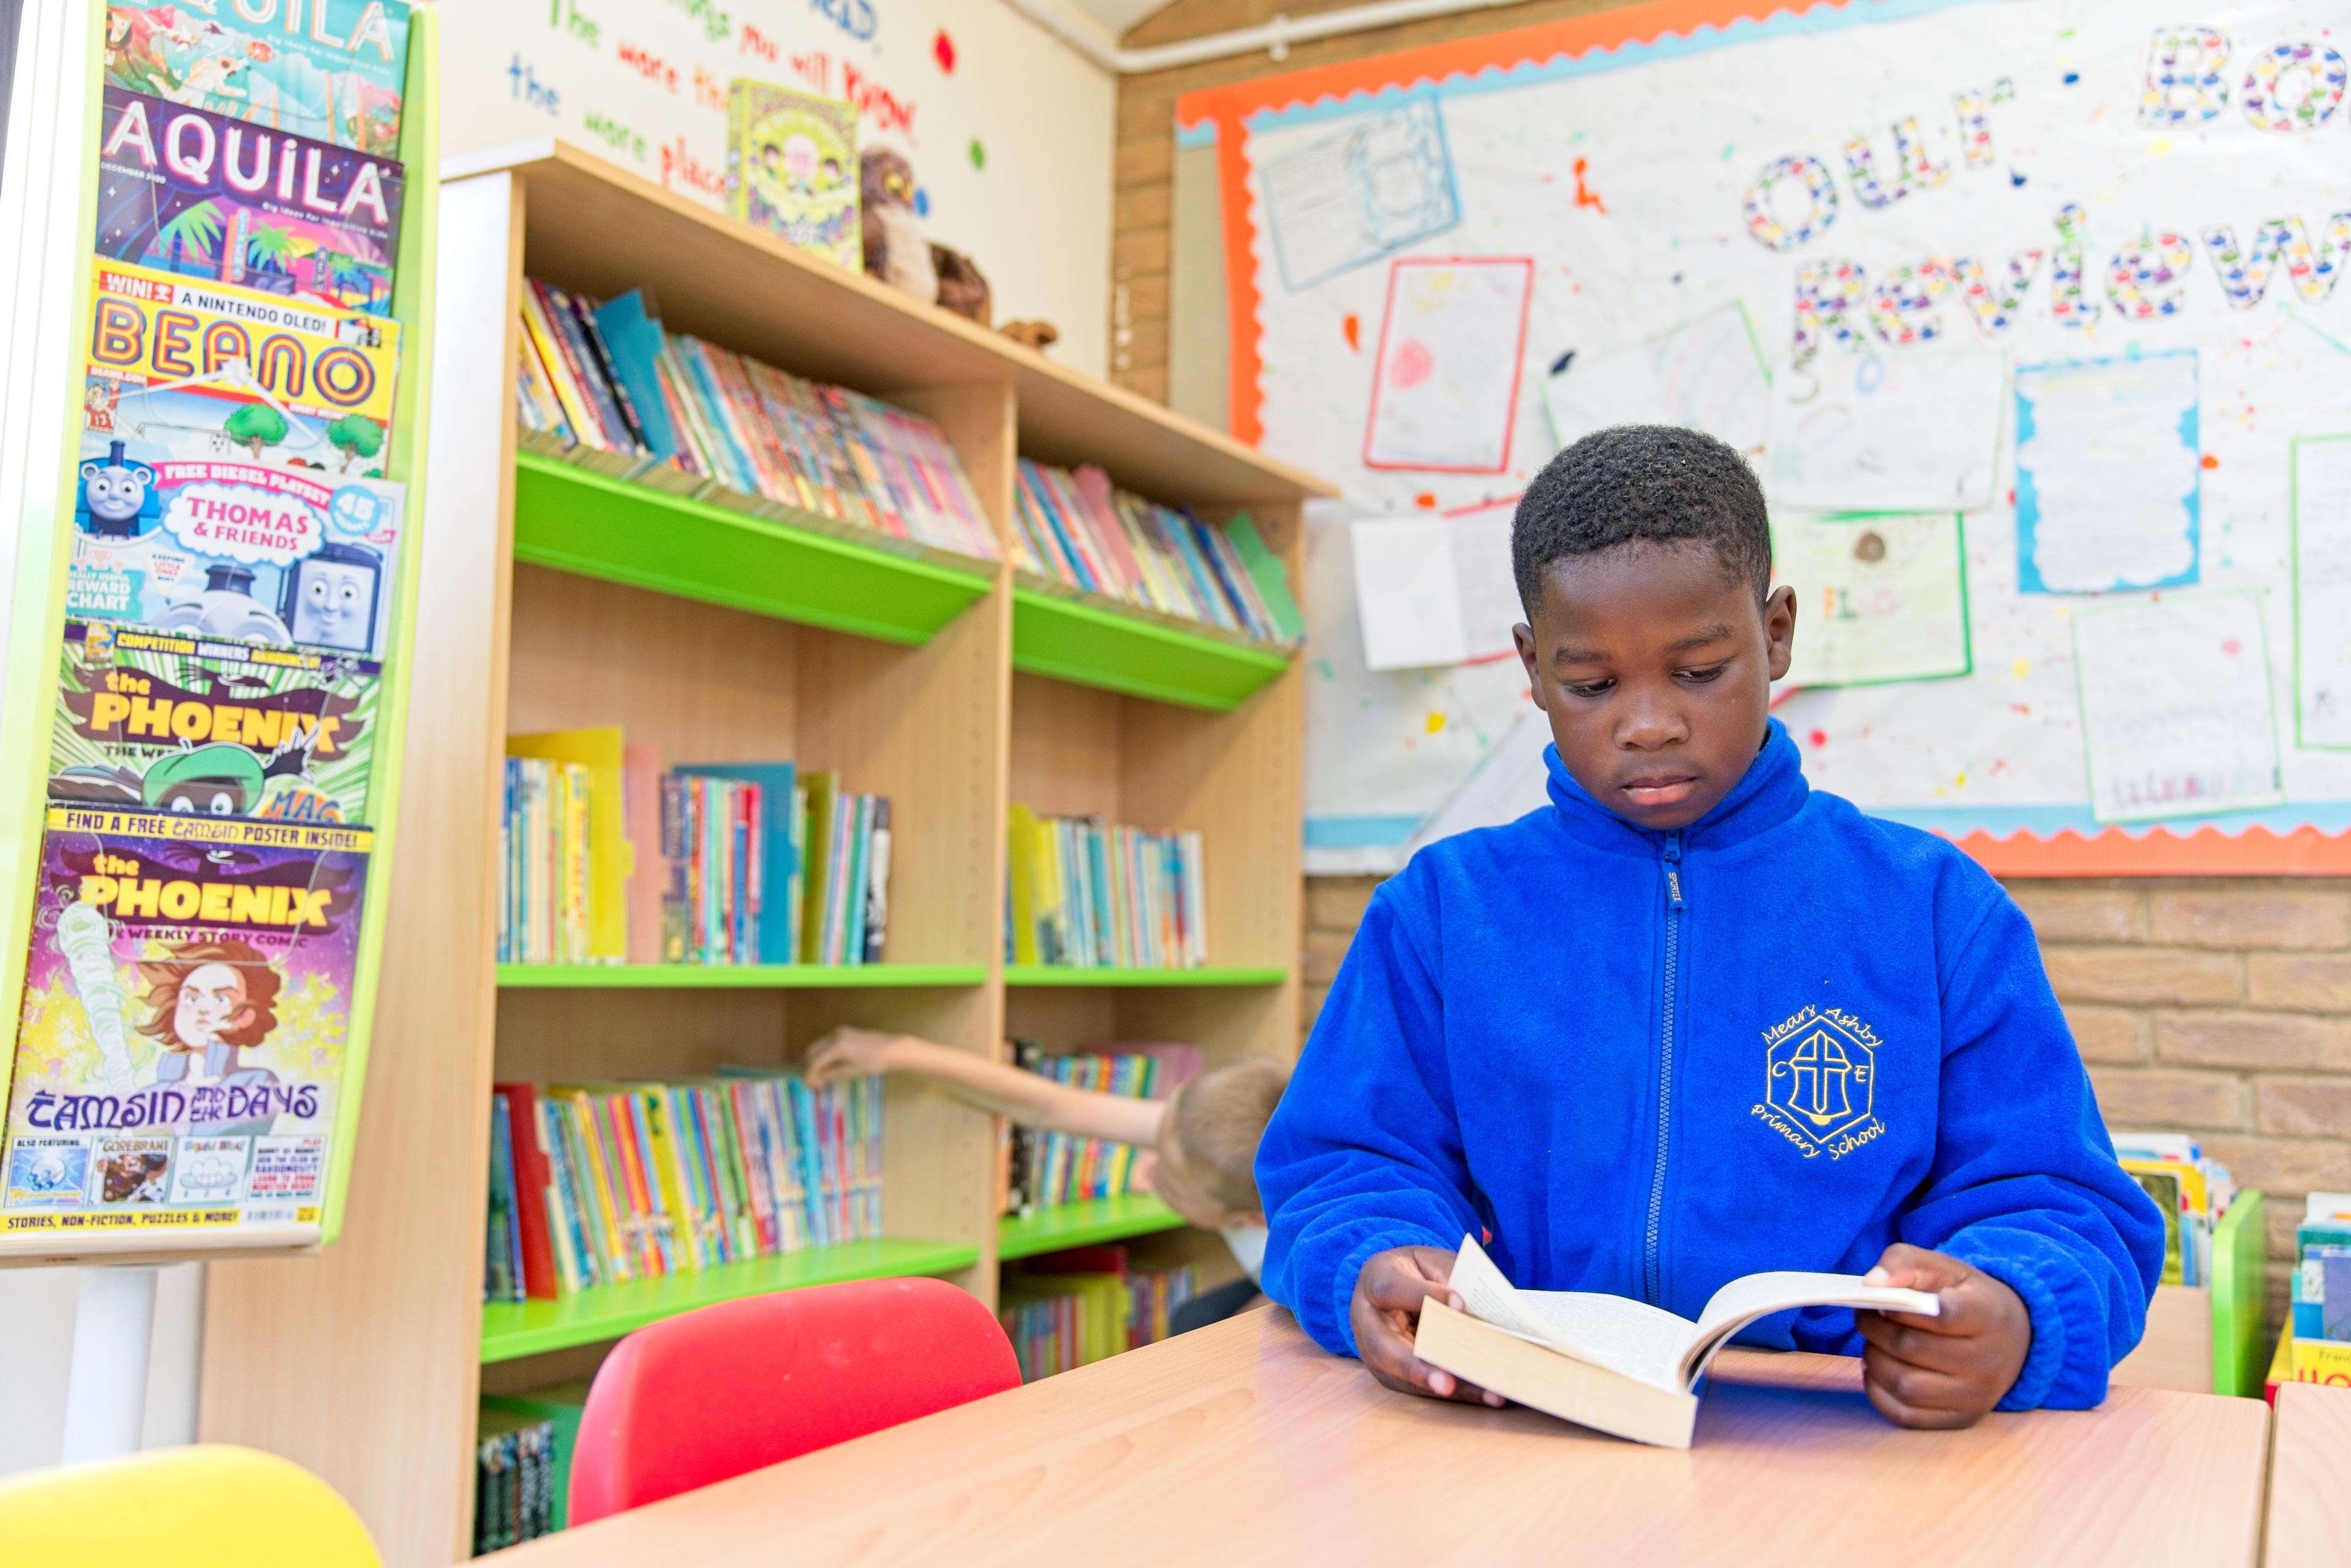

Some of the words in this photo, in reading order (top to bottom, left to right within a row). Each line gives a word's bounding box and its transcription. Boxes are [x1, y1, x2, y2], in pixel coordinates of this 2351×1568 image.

[106, 272, 152, 299] WIN!
[182, 292, 192, 306] A
[197, 294, 278, 324] NINTENDO
[283, 312, 327, 334] OLED!
[92, 297, 376, 407] BEANO
[163, 464, 208, 480] FREE
[209, 464, 268, 486] DIESEL
[268, 471, 333, 507] PLAYSET
[187, 496, 308, 535] THOMAS
[337, 492, 376, 521] 45
[193, 521, 209, 537] &
[214, 525, 298, 552] FRIENDS
[66, 592, 130, 612] CHART
[68, 579, 131, 596] REWARD
[116, 632, 196, 656] COMPETITION
[105, 671, 151, 695] the
[90, 692, 341, 753] PHOENIX
[104, 745, 138, 757] THE
[66, 812, 104, 830] FIND
[111, 816, 120, 831] A
[128, 817, 166, 835] FREE
[243, 826, 299, 844] POSTER
[305, 830, 358, 849] INSIDE!
[92, 853, 140, 875] the
[81, 874, 333, 928] PHOENIX
[1668, 871, 1683, 902] SPORTEX
[129, 928, 195, 941] WEEKLY
[1825, 1008, 1883, 1047] Ashby
[1771, 1061, 1788, 1078] C
[1854, 1065, 1870, 1082] E
[226, 1084, 319, 1119] DAYS
[1750, 1104, 1821, 1158] Primary
[1827, 1116, 1885, 1161] School
[7, 1215, 56, 1229] STORIES,
[61, 1214, 137, 1227] NON-FICTION,
[141, 1213, 188, 1224] PUZZLES
[205, 1211, 239, 1223] MORE!
